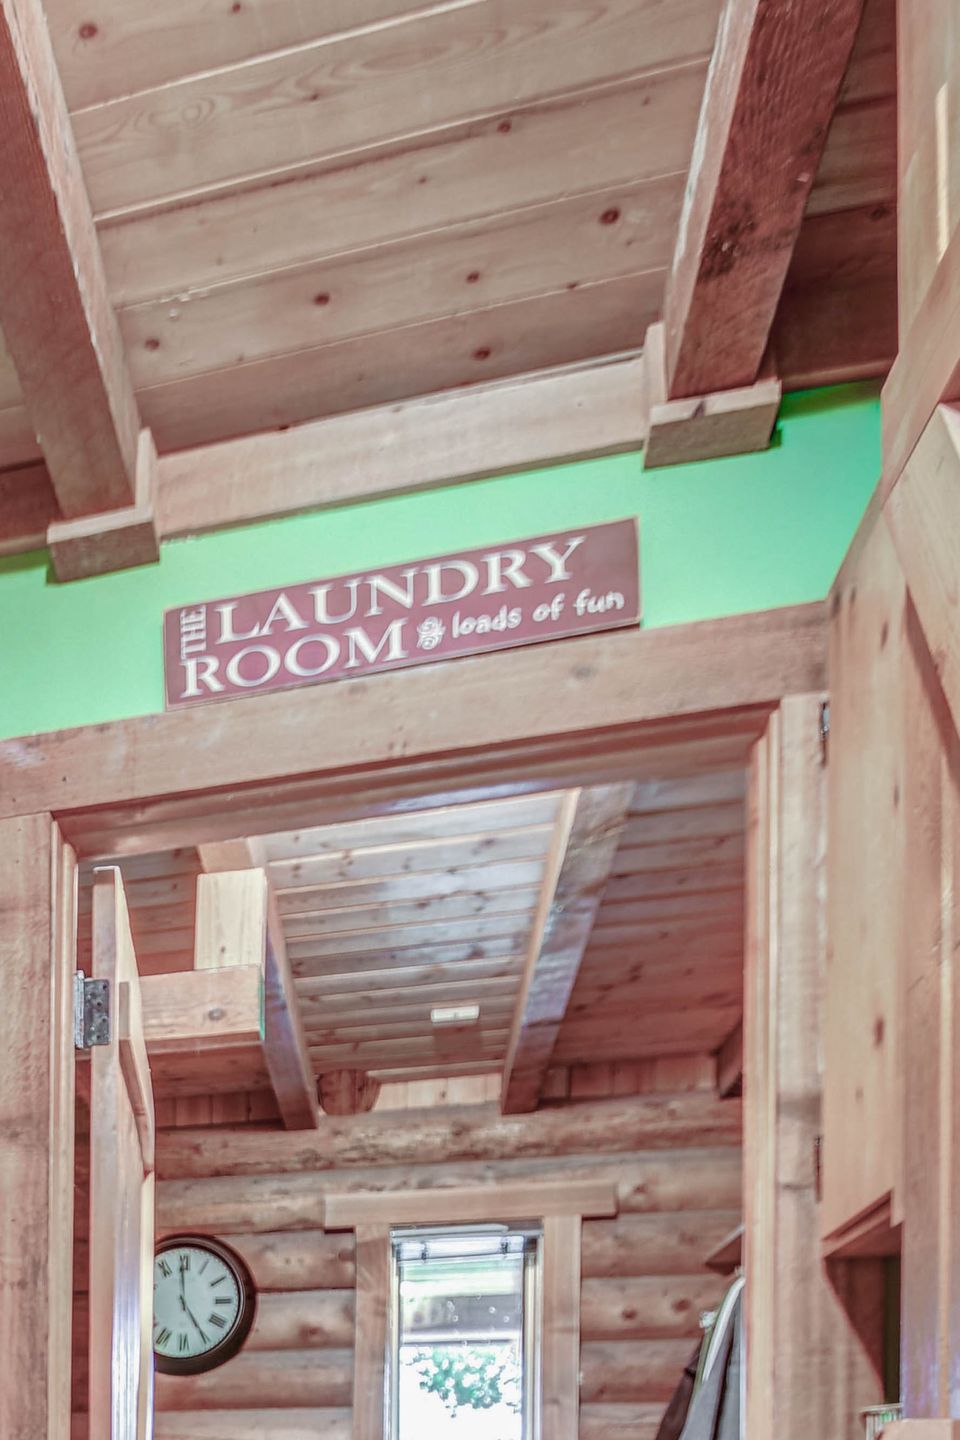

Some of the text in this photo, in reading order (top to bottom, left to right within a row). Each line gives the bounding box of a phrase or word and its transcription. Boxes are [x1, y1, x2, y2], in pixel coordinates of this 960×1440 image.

[214, 536, 587, 645] LAUNDRY
[451, 588, 625, 638] loads of fun
[180, 605, 206, 660] THE
[180, 617, 410, 698] ROOM
